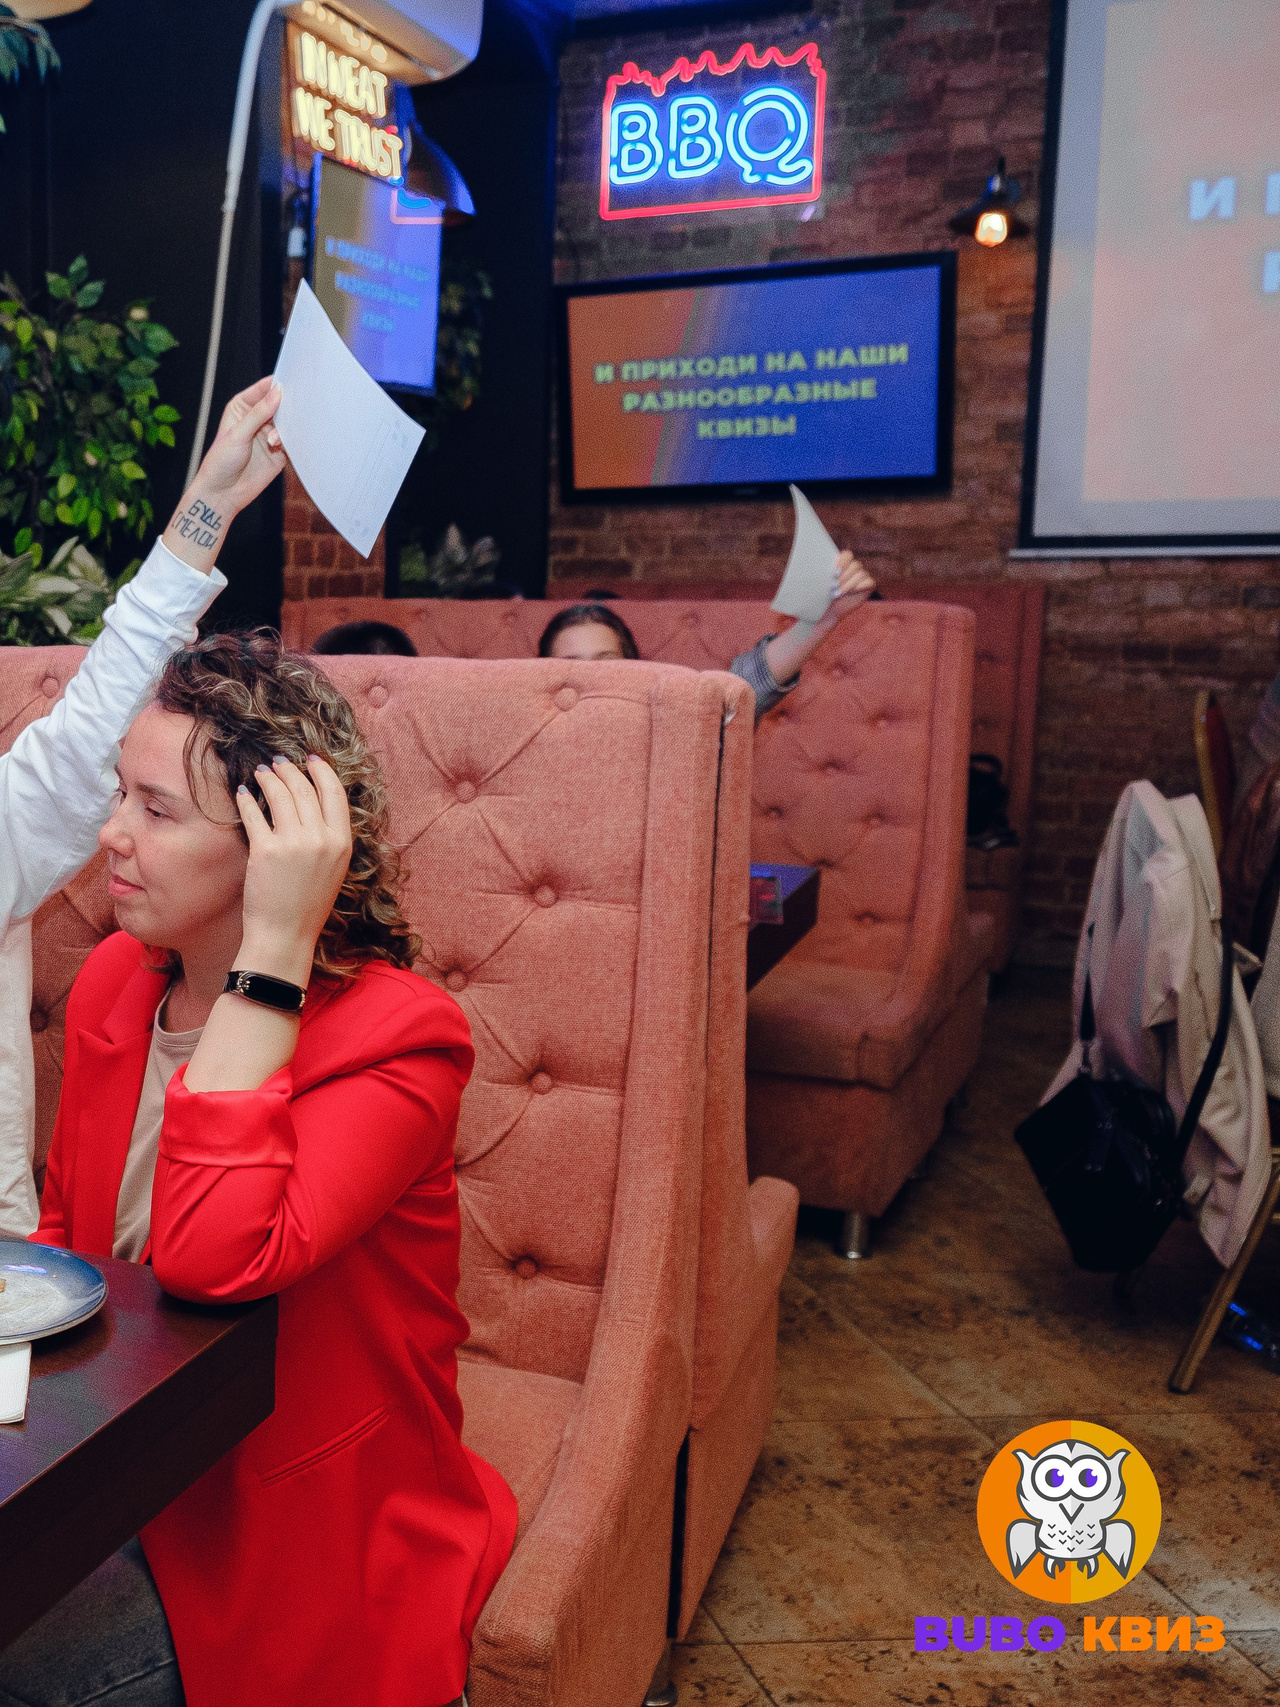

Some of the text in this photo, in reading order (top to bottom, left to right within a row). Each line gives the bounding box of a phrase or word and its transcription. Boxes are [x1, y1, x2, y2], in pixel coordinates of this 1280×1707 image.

[609, 87, 814, 186] BBQ
[594, 344, 909, 385] И ПРИХОДИ НА НАШИ
[622, 377, 878, 413] РАЗНООБРАЗНЫЕ
[697, 415, 797, 439] КВИЗЫ
